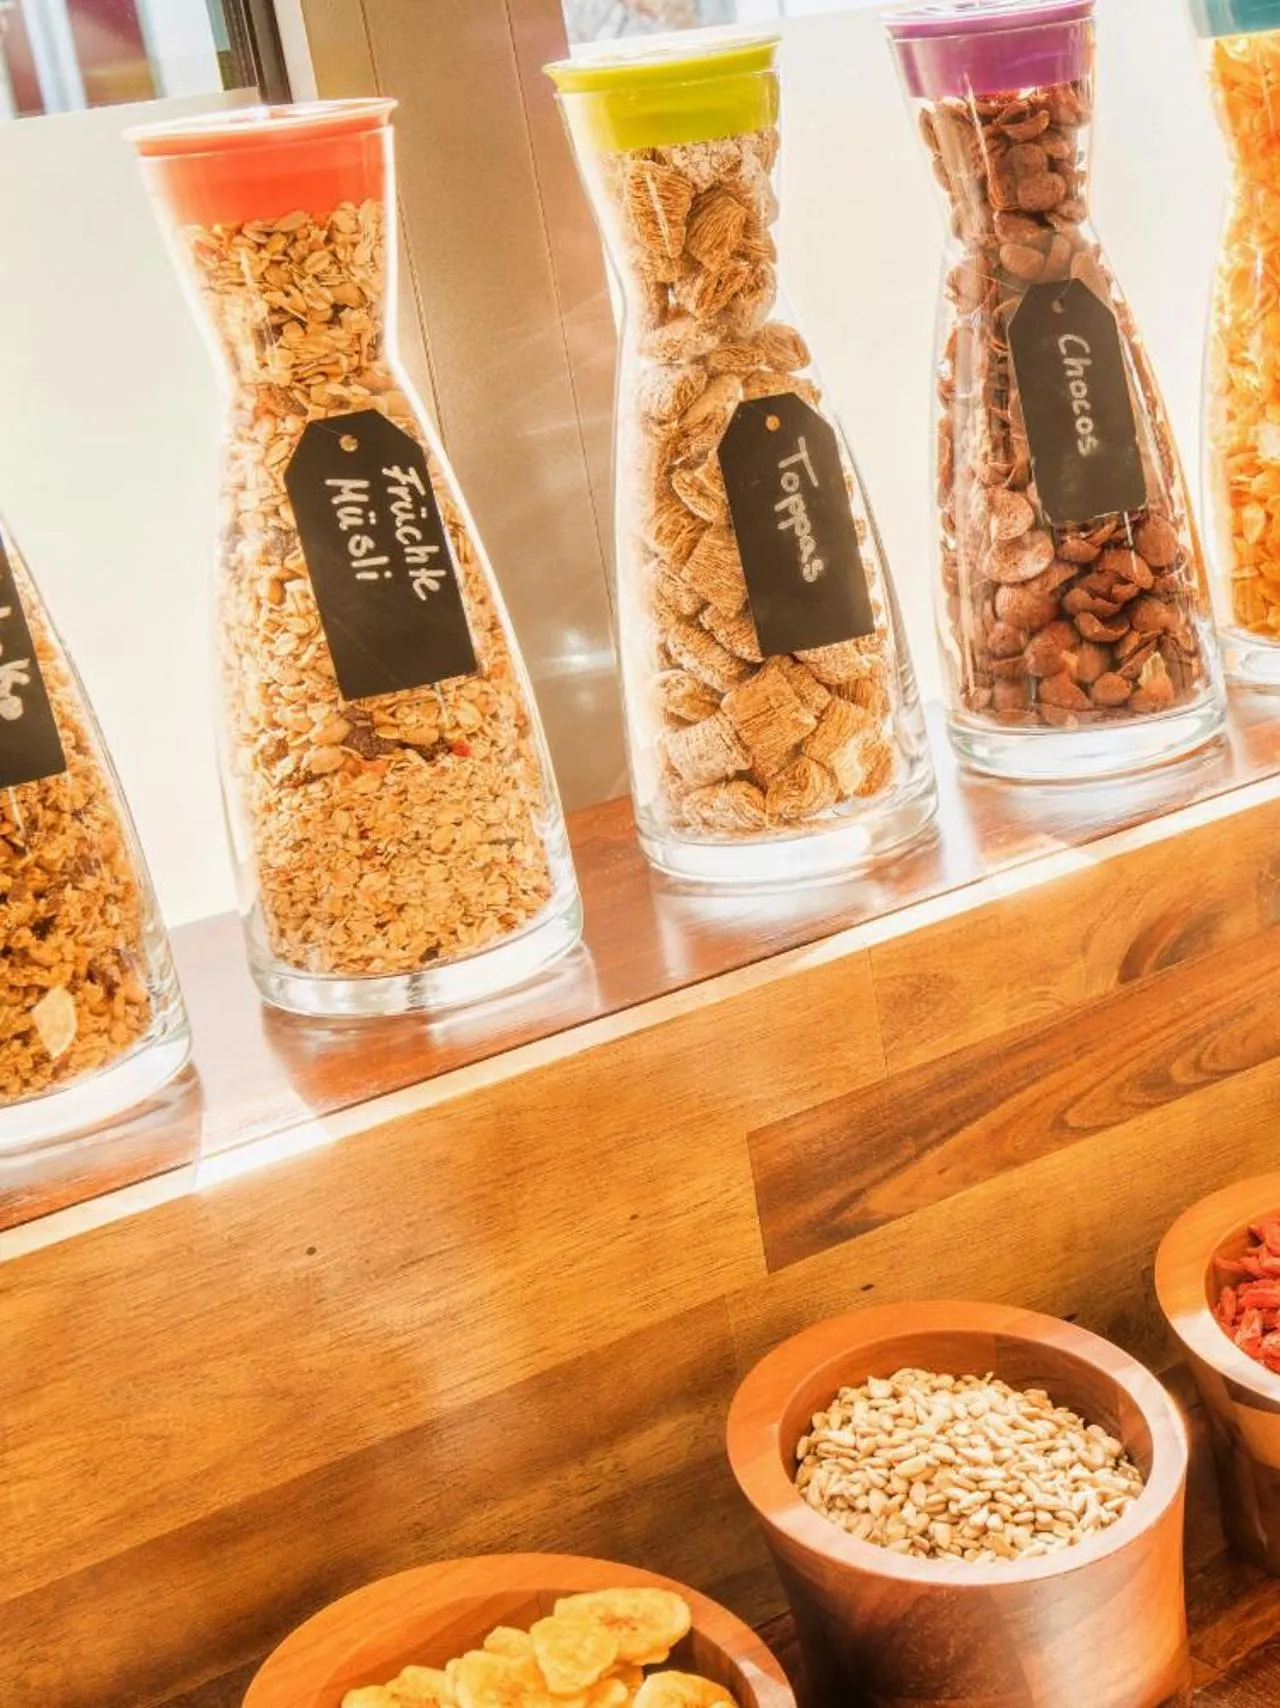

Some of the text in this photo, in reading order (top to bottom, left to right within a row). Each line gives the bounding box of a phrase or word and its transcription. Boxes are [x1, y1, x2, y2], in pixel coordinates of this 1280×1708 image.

[1057, 333, 1099, 457] Chocos
[324, 478, 393, 580] Müsli
[381, 465, 447, 601] Früchte
[773, 436, 825, 582] Toppas
